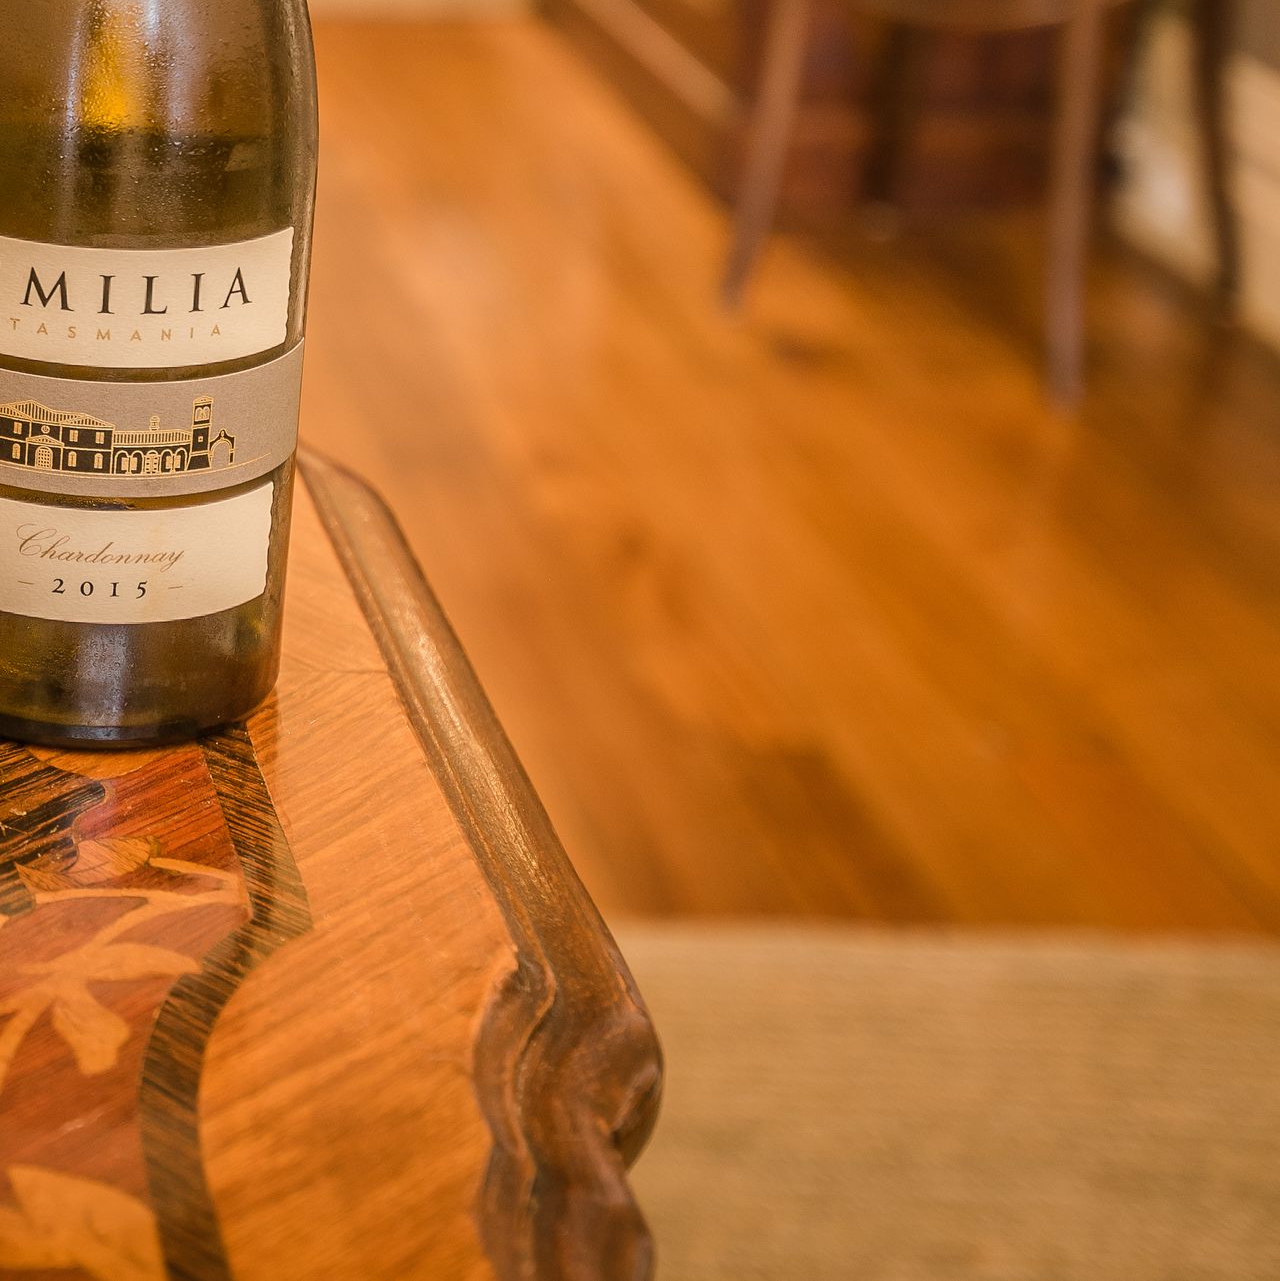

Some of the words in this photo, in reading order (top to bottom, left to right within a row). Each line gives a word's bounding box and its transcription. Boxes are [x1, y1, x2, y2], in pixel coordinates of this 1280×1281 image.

[9, 317, 222, 343] TASMANIA
[15, 522, 186, 577] Chardonnay
[51, 577, 149, 600] 2015
